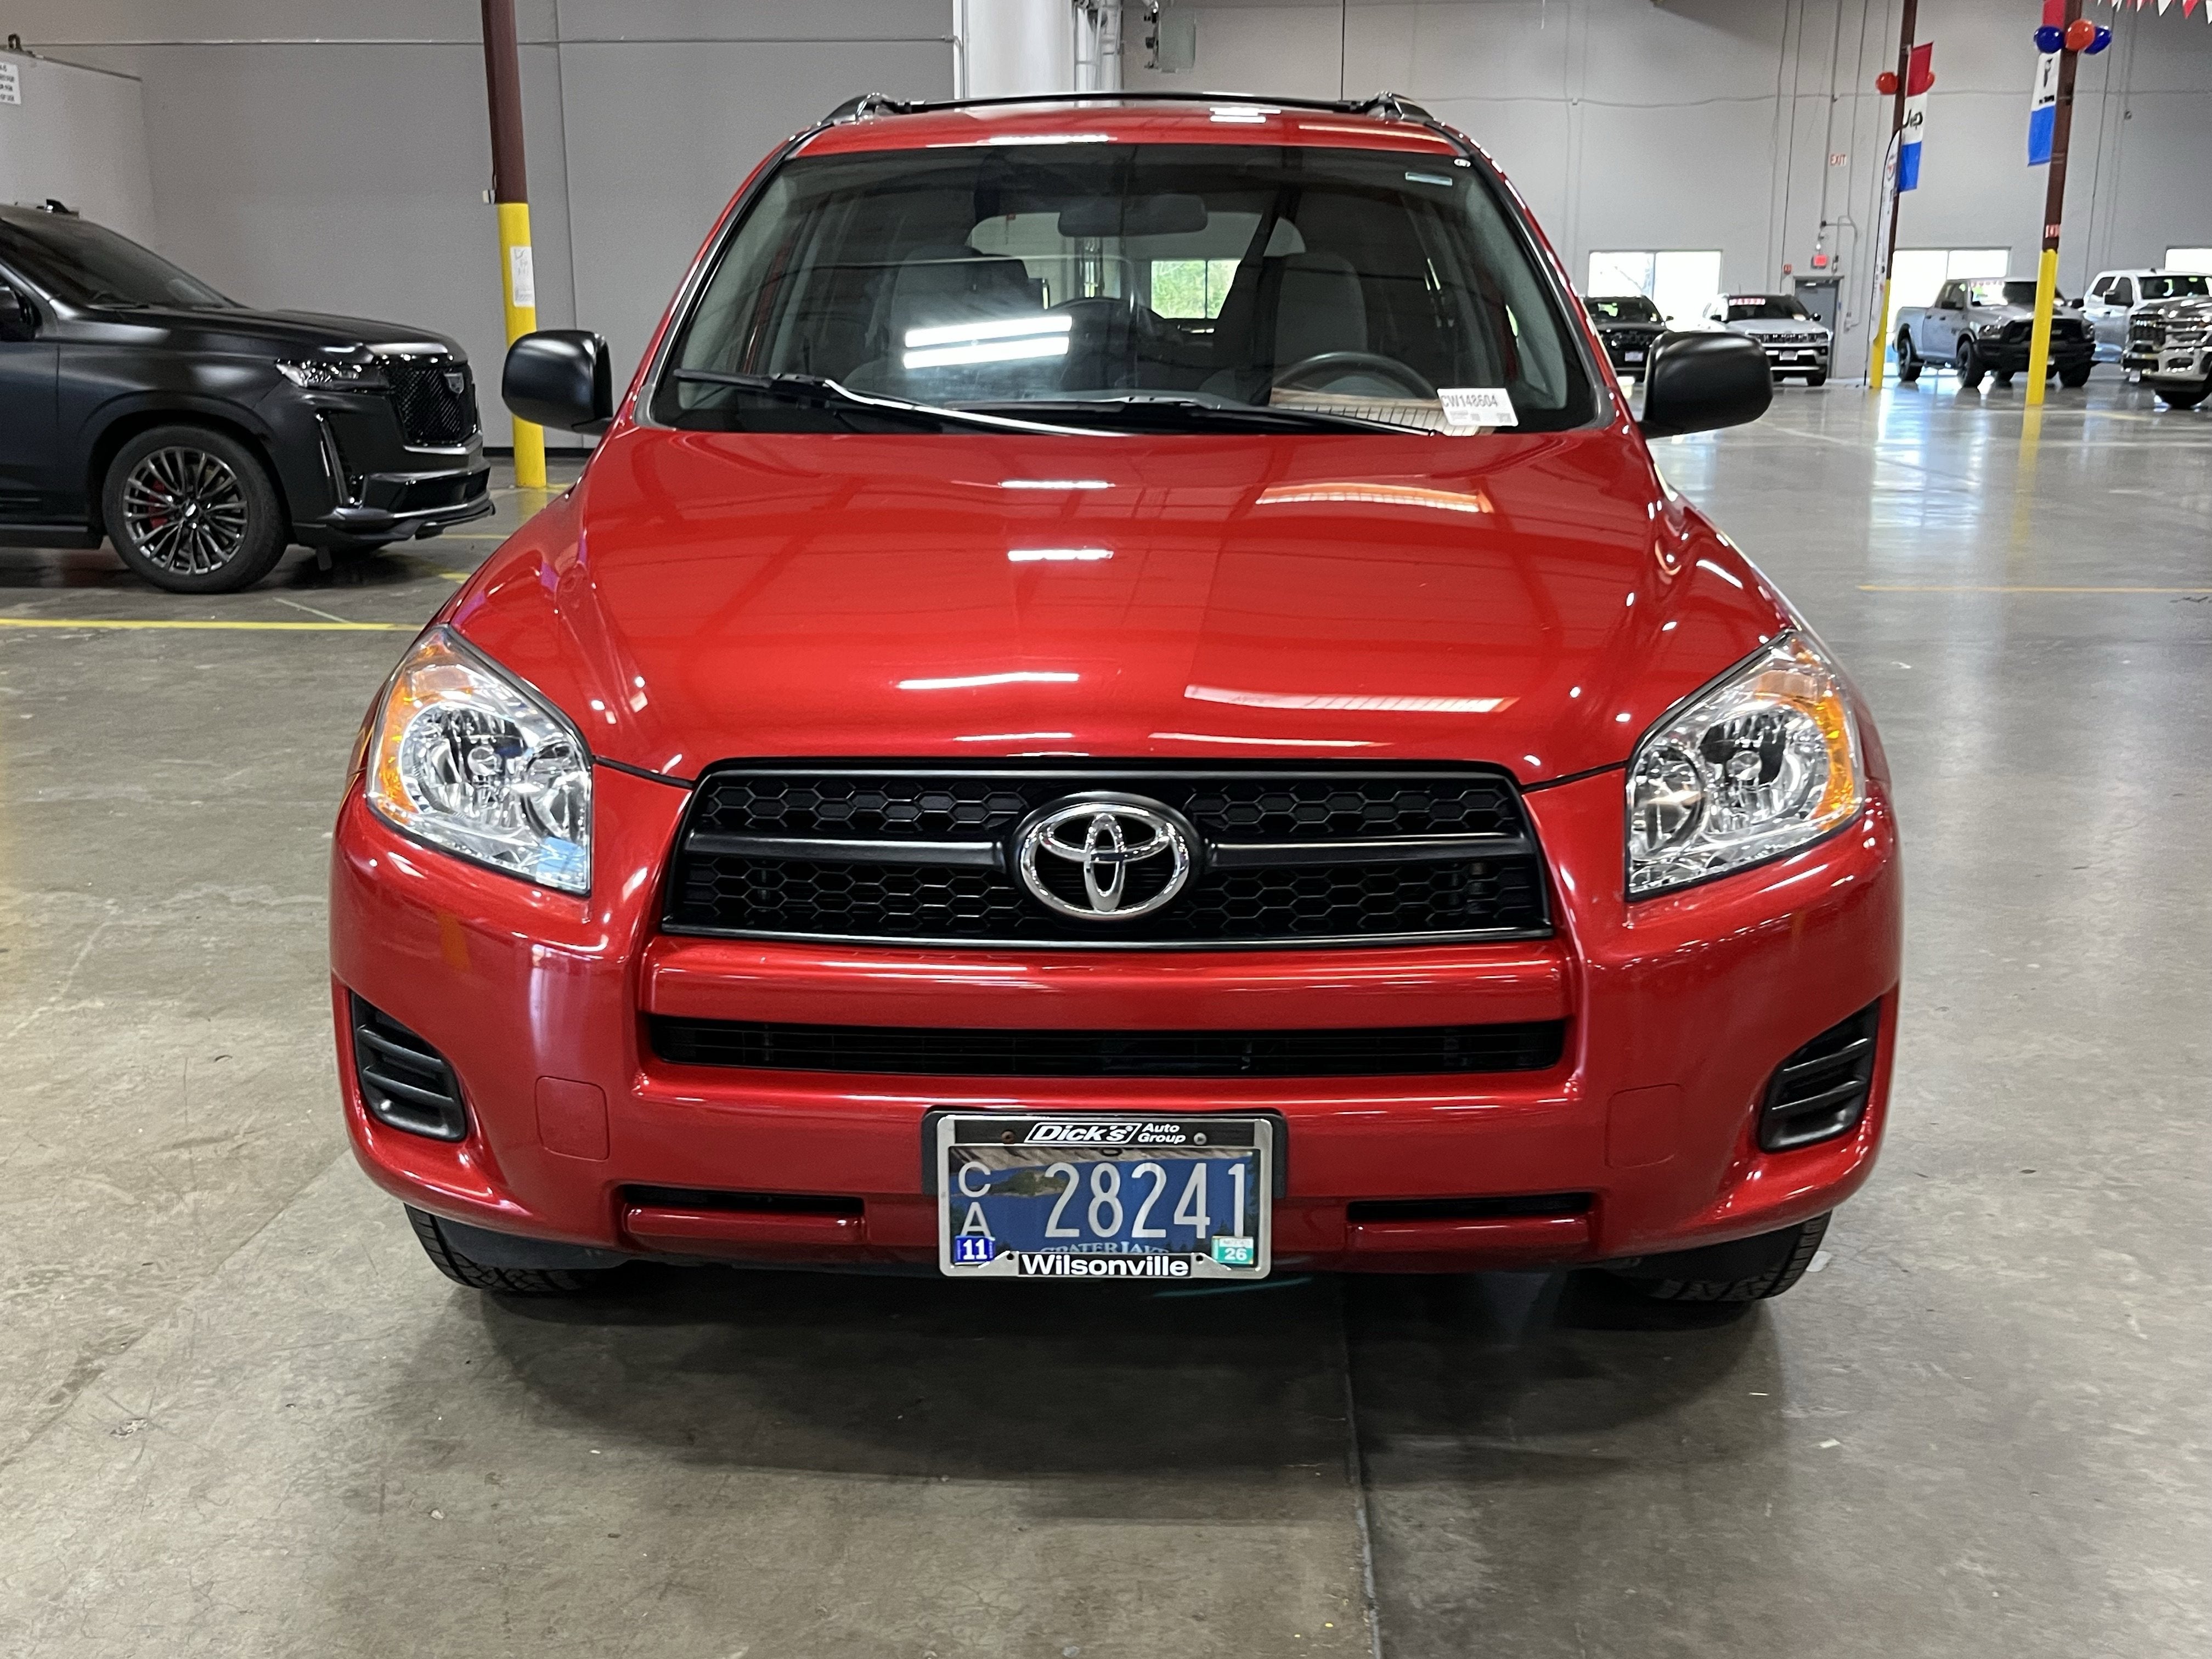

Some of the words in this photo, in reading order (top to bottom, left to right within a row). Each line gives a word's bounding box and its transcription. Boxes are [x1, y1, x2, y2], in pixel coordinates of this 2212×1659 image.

[1032, 1125, 1127, 1142] Dick's
[1142, 1124, 1180, 1133] Auto
[1137, 1133, 1186, 1144] Group
[1044, 1161, 1244, 1238] 28241
[963, 1239, 988, 1260] 11
[1224, 1247, 1247, 1261] 26
[1022, 1254, 1189, 1276] Wilsonville
